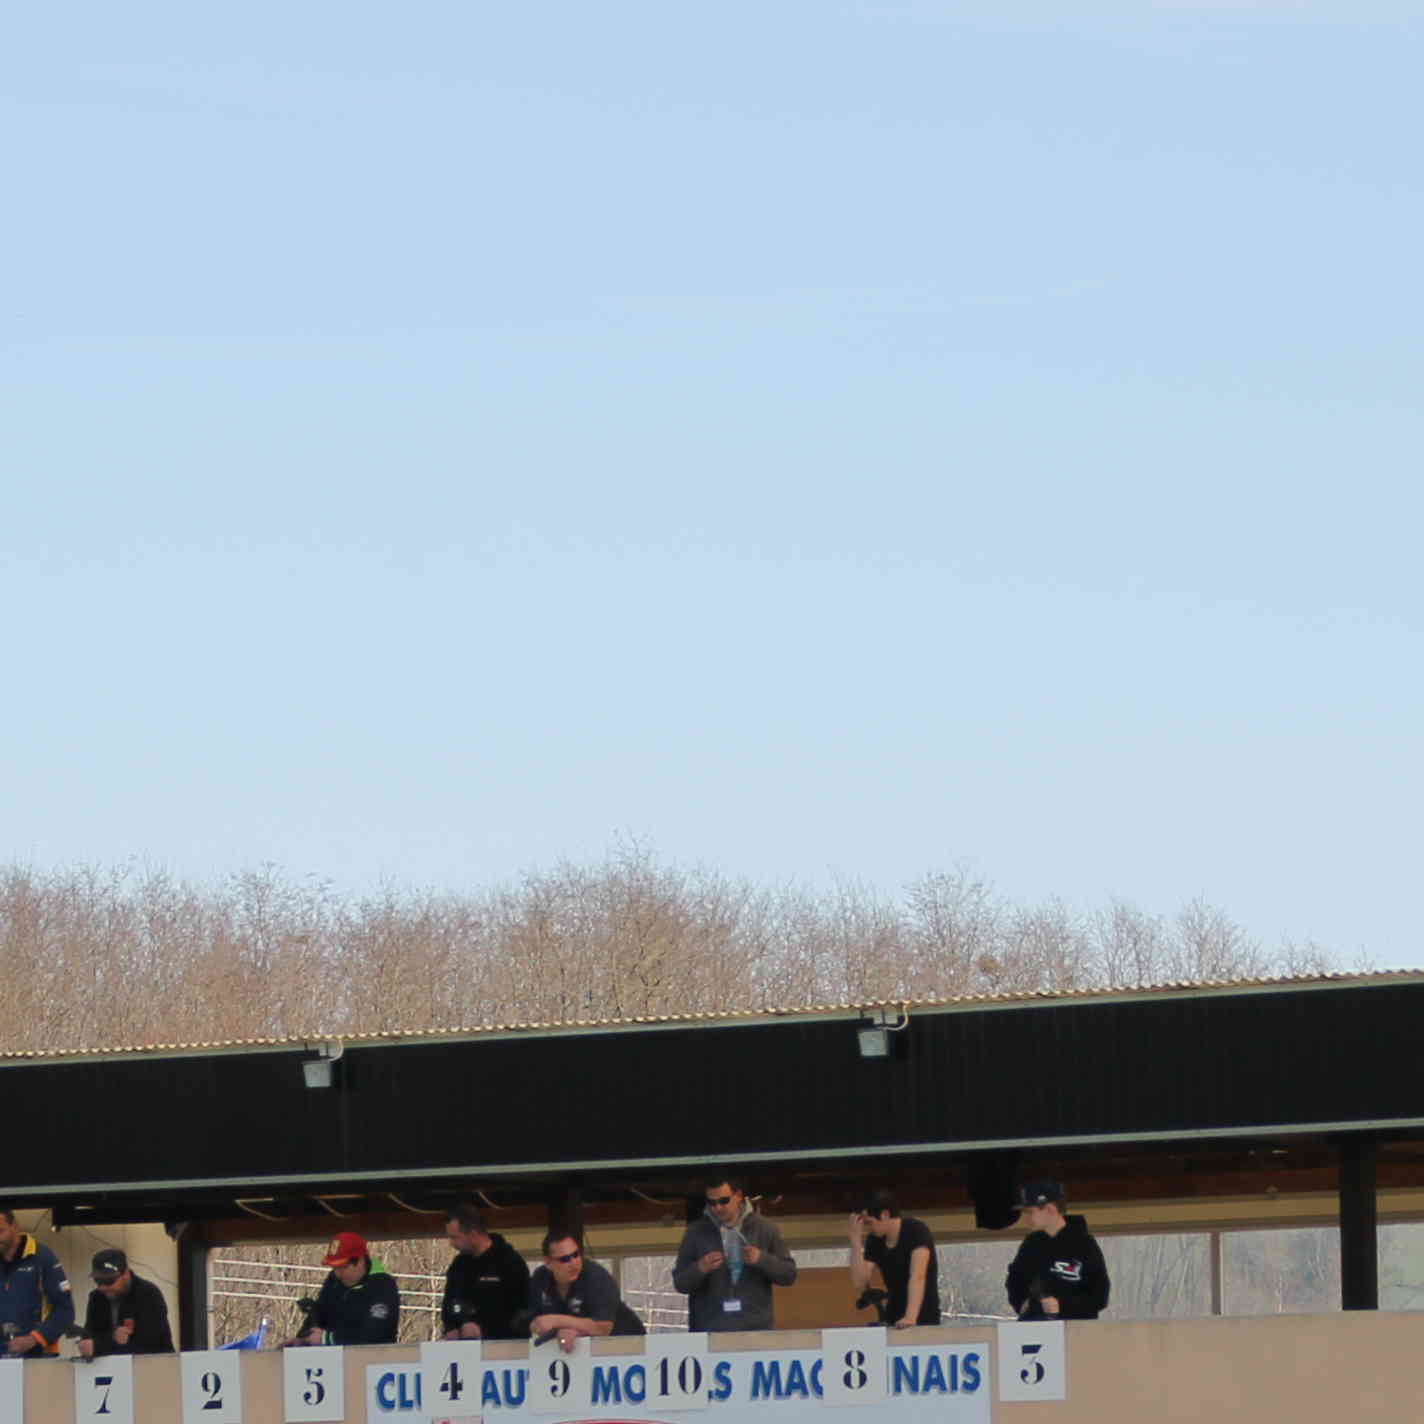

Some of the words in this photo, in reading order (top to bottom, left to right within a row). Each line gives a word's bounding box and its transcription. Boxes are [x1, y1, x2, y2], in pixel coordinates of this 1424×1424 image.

[303, 1367, 325, 1406] 5
[440, 1362, 463, 1401] 4
[549, 1359, 571, 1398] 9
[656, 1355, 702, 1396] 10
[843, 1350, 867, 1390] 8
[93, 1376, 114, 1415] 7
[201, 1371, 223, 1410] 2
